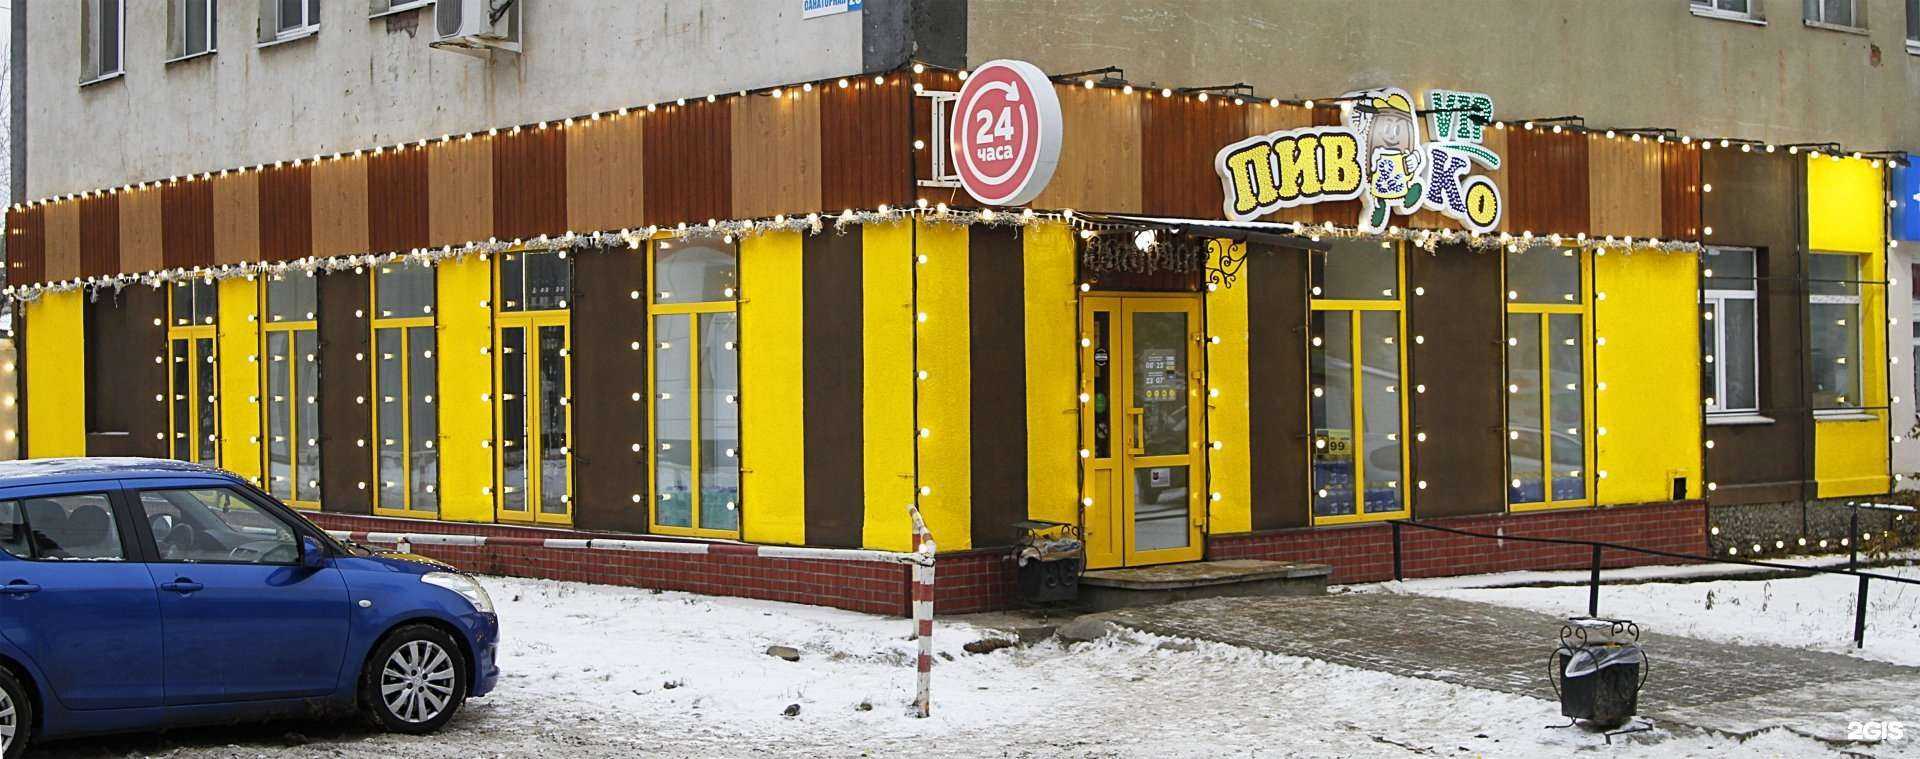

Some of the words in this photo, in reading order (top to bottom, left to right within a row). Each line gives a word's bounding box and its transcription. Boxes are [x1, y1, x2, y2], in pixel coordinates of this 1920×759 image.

[976, 106, 1014, 144] 24
[1432, 92, 1492, 140] VIP
[977, 144, 1013, 161] часа
[1227, 132, 1362, 215] ПИВ
[1330, 441, 1345, 451] 99
